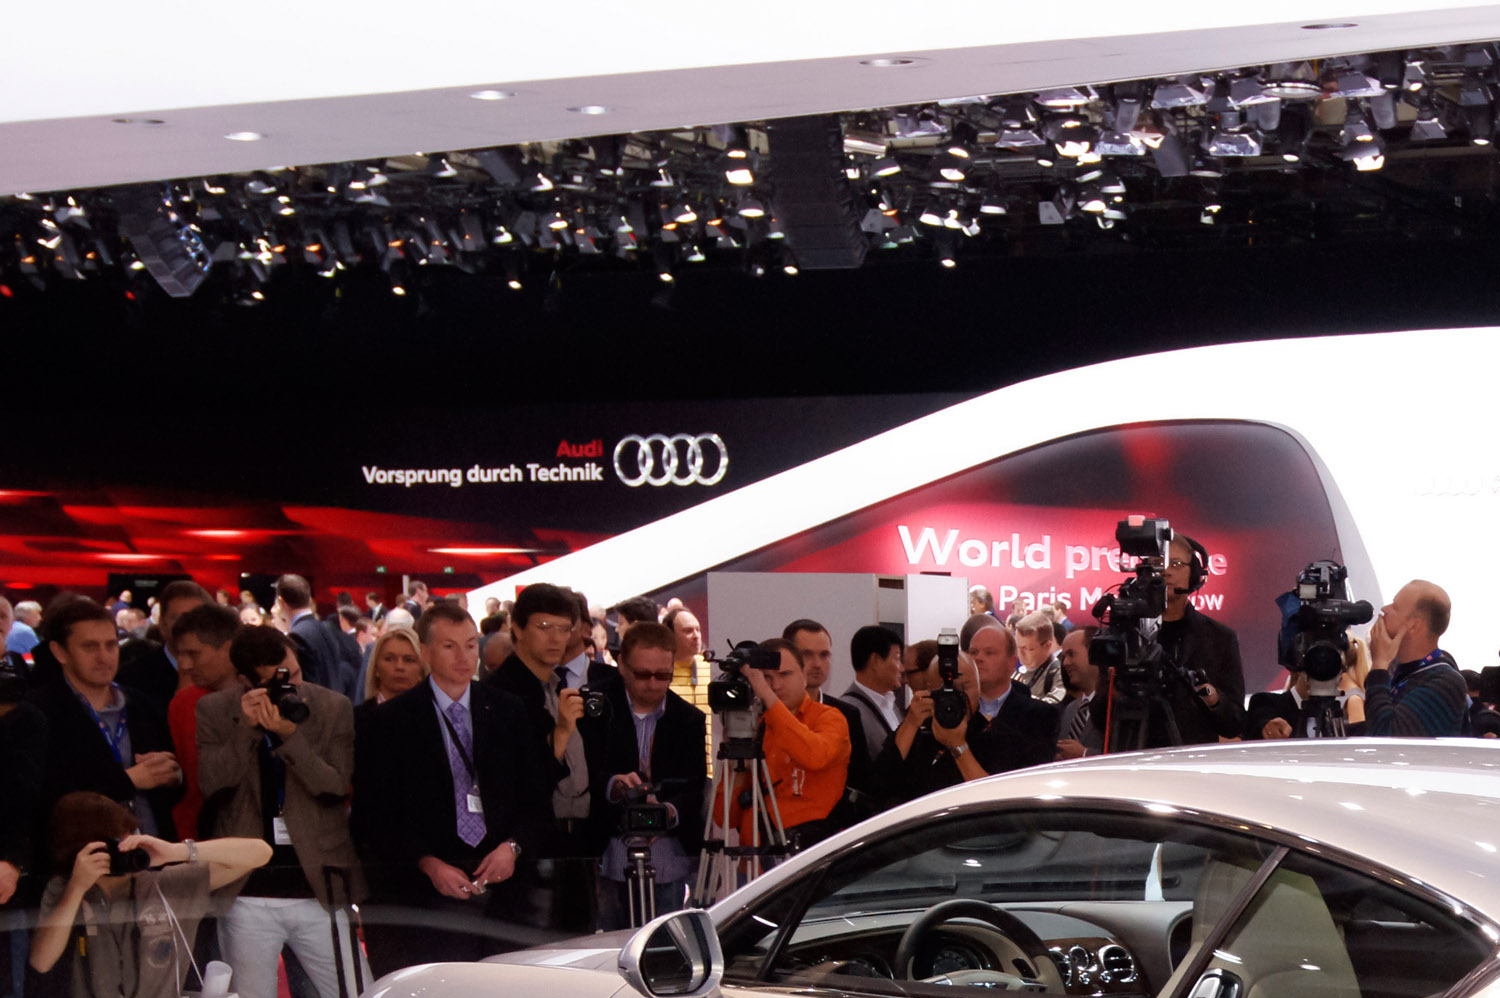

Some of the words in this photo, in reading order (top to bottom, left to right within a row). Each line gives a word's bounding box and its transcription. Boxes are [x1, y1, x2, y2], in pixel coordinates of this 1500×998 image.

[556, 440, 602, 457] Audi
[362, 466, 462, 487] Vorsprung
[467, 464, 522, 482] durch
[527, 463, 603, 481] Technik
[897, 525, 1051, 570] World
[999, 585, 1072, 611] Paris
